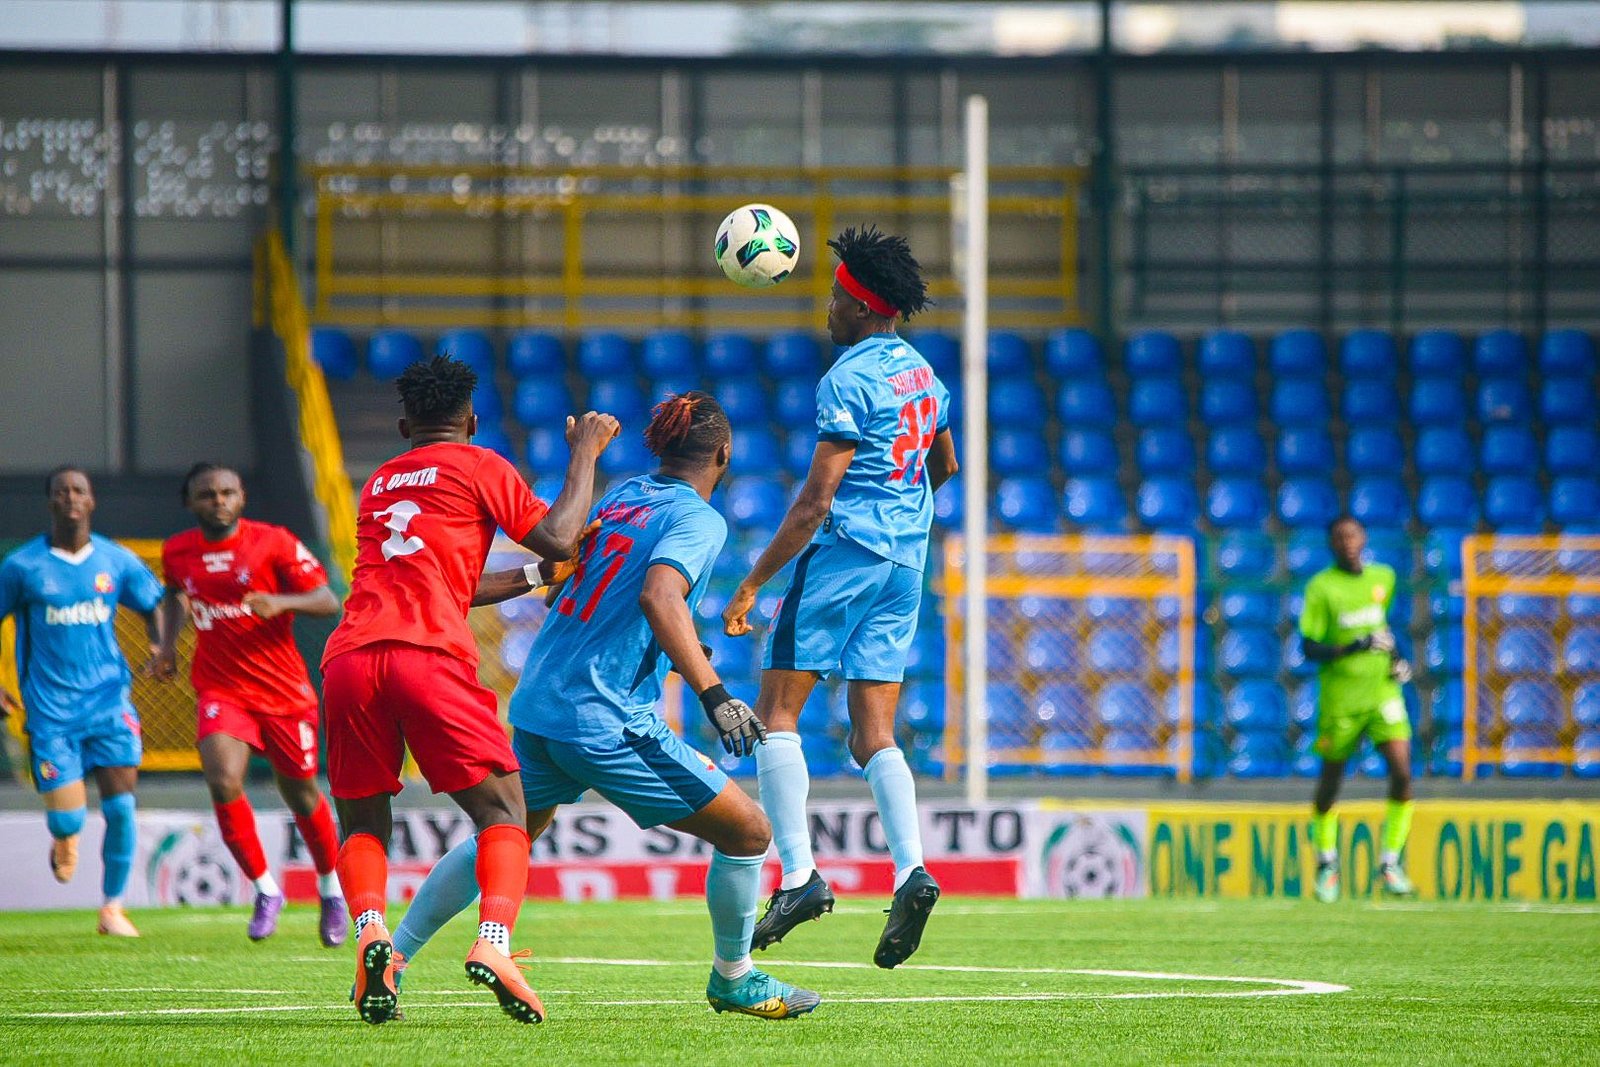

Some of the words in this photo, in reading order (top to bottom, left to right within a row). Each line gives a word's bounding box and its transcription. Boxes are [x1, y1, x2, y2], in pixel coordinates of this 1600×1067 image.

[386, 466, 439, 491] OPUTA
[373, 500, 425, 562] 2
[931, 810, 1023, 852] TO
[1150, 822, 1232, 897] ONE
[1250, 821, 1405, 897] NAO
[1436, 821, 1523, 898] ONE
